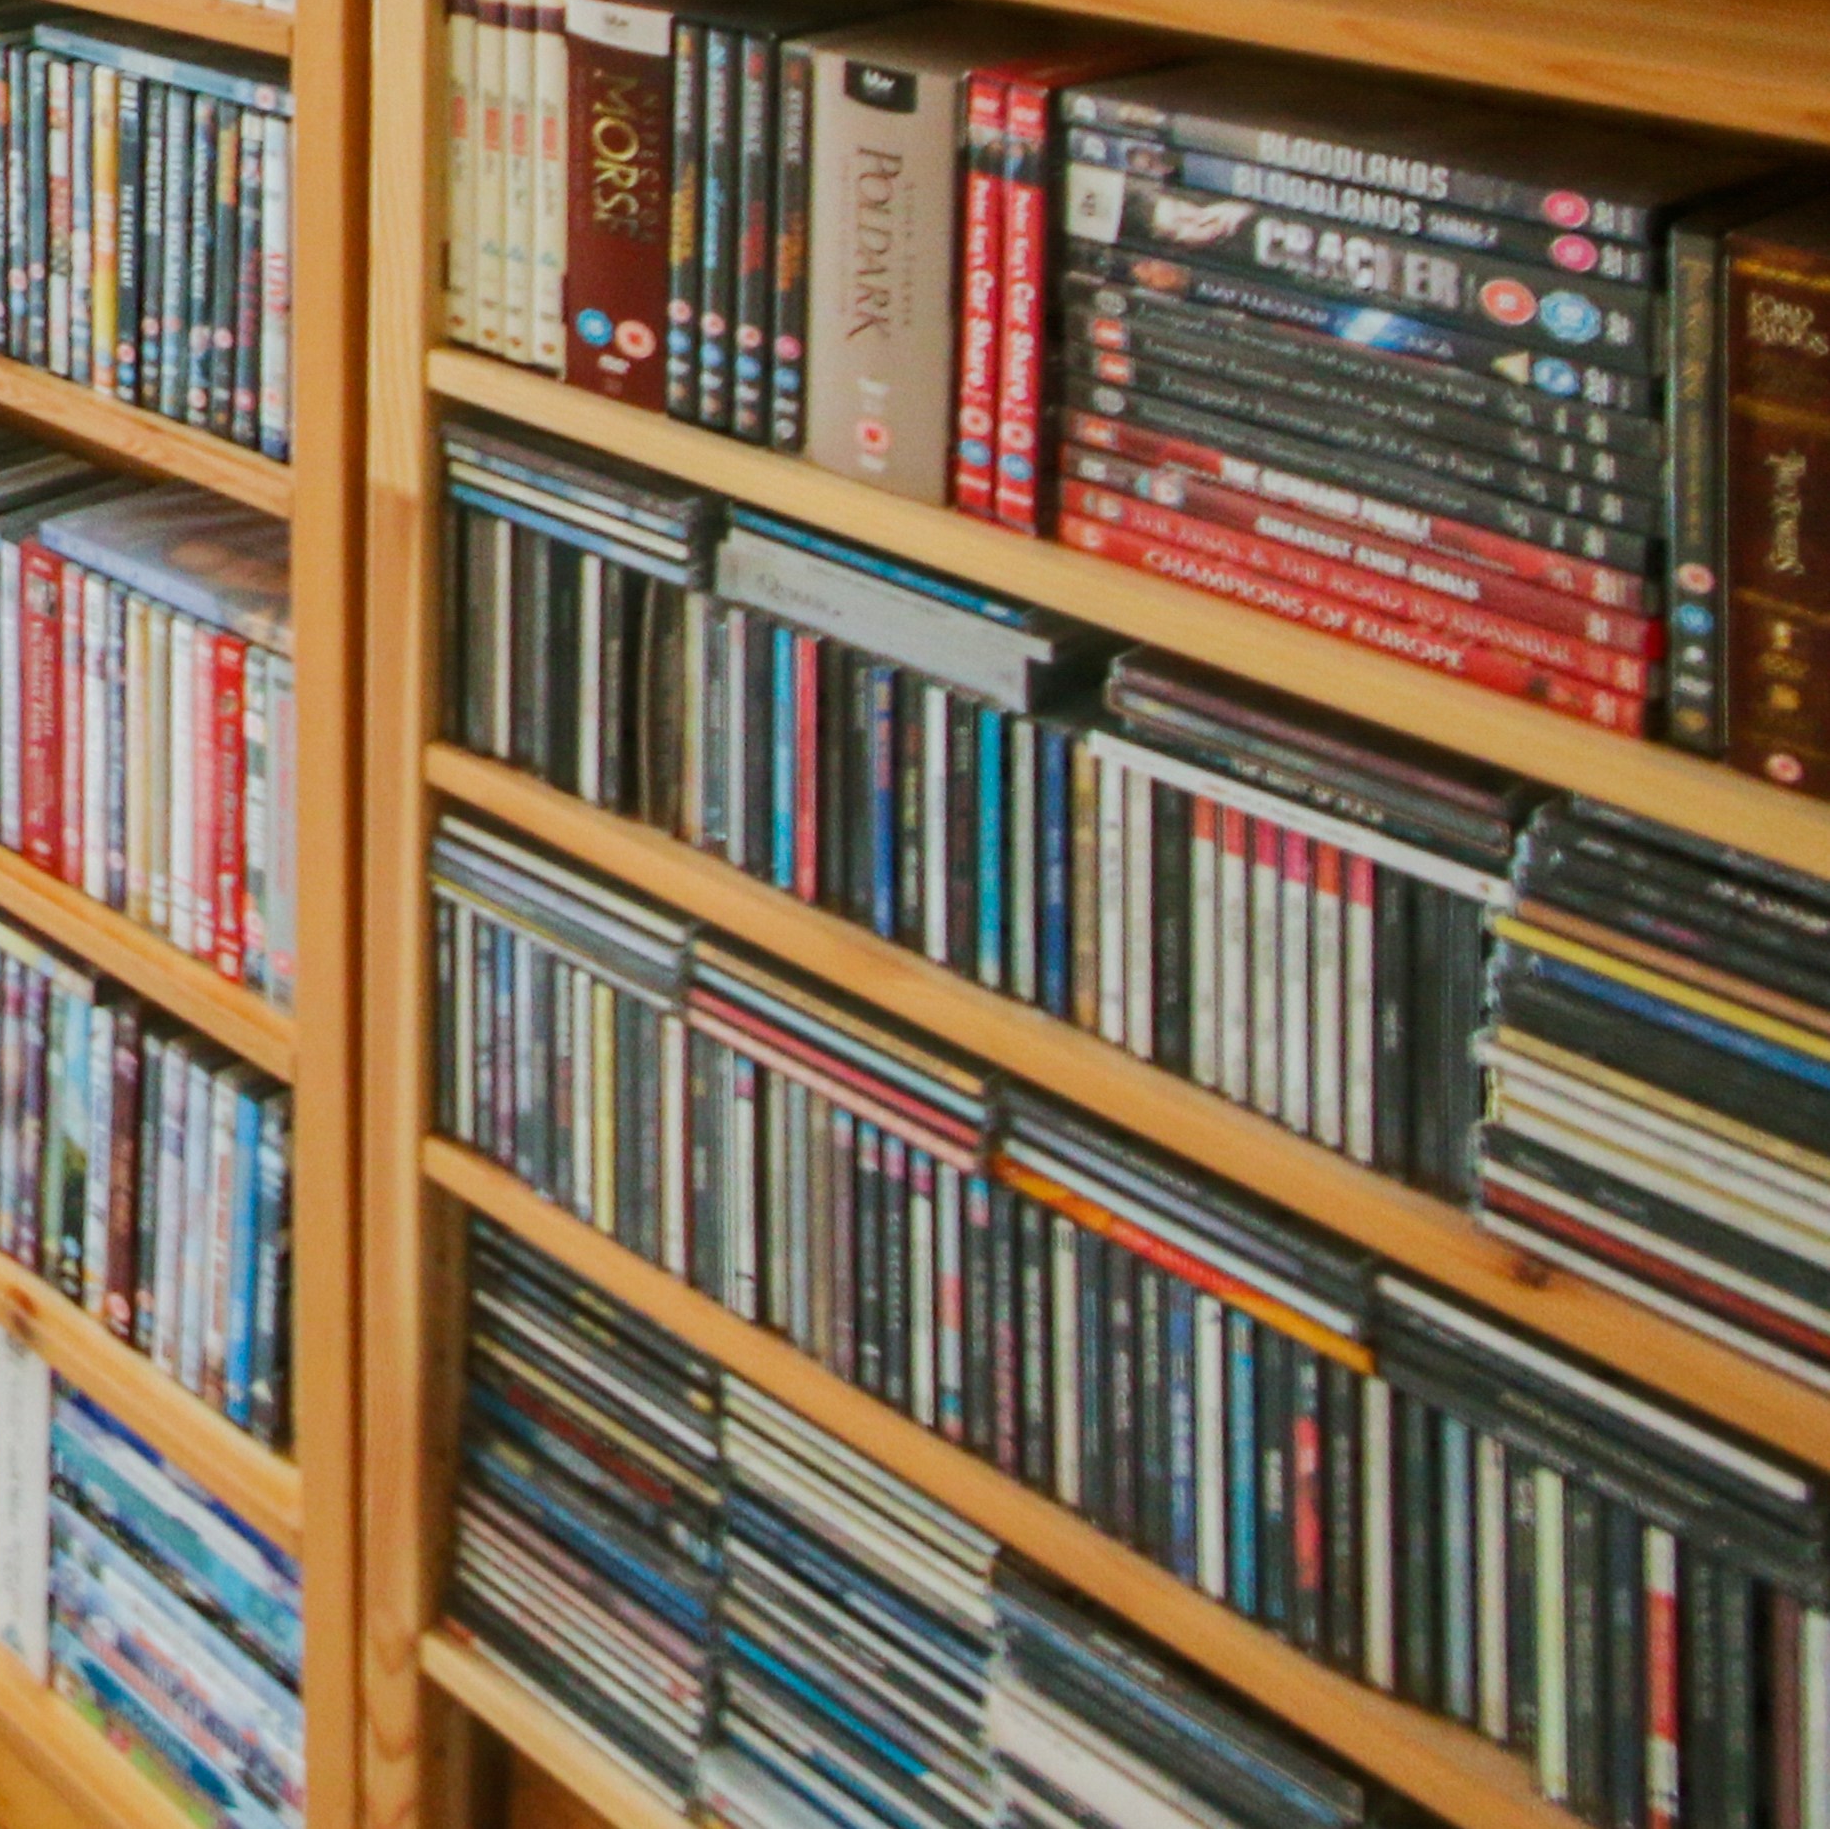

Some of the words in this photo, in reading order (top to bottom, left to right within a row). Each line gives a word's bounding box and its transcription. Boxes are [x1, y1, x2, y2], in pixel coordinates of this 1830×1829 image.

[592, 69, 640, 232] MORSE
[1258, 130, 1450, 200] BLOODLANDS
[1232, 163, 1422, 236] BLOODLANDS
[847, 147, 904, 340] POLDARK
[970, 269, 995, 314] Car
[1010, 282, 1036, 325] Car
[965, 318, 994, 389] Share
[1007, 330, 1035, 401] Share
[1143, 549, 1306, 619] CHAMPIONS
[1307, 604, 1348, 631] OF
[1351, 617, 1464, 669] EUROPE
